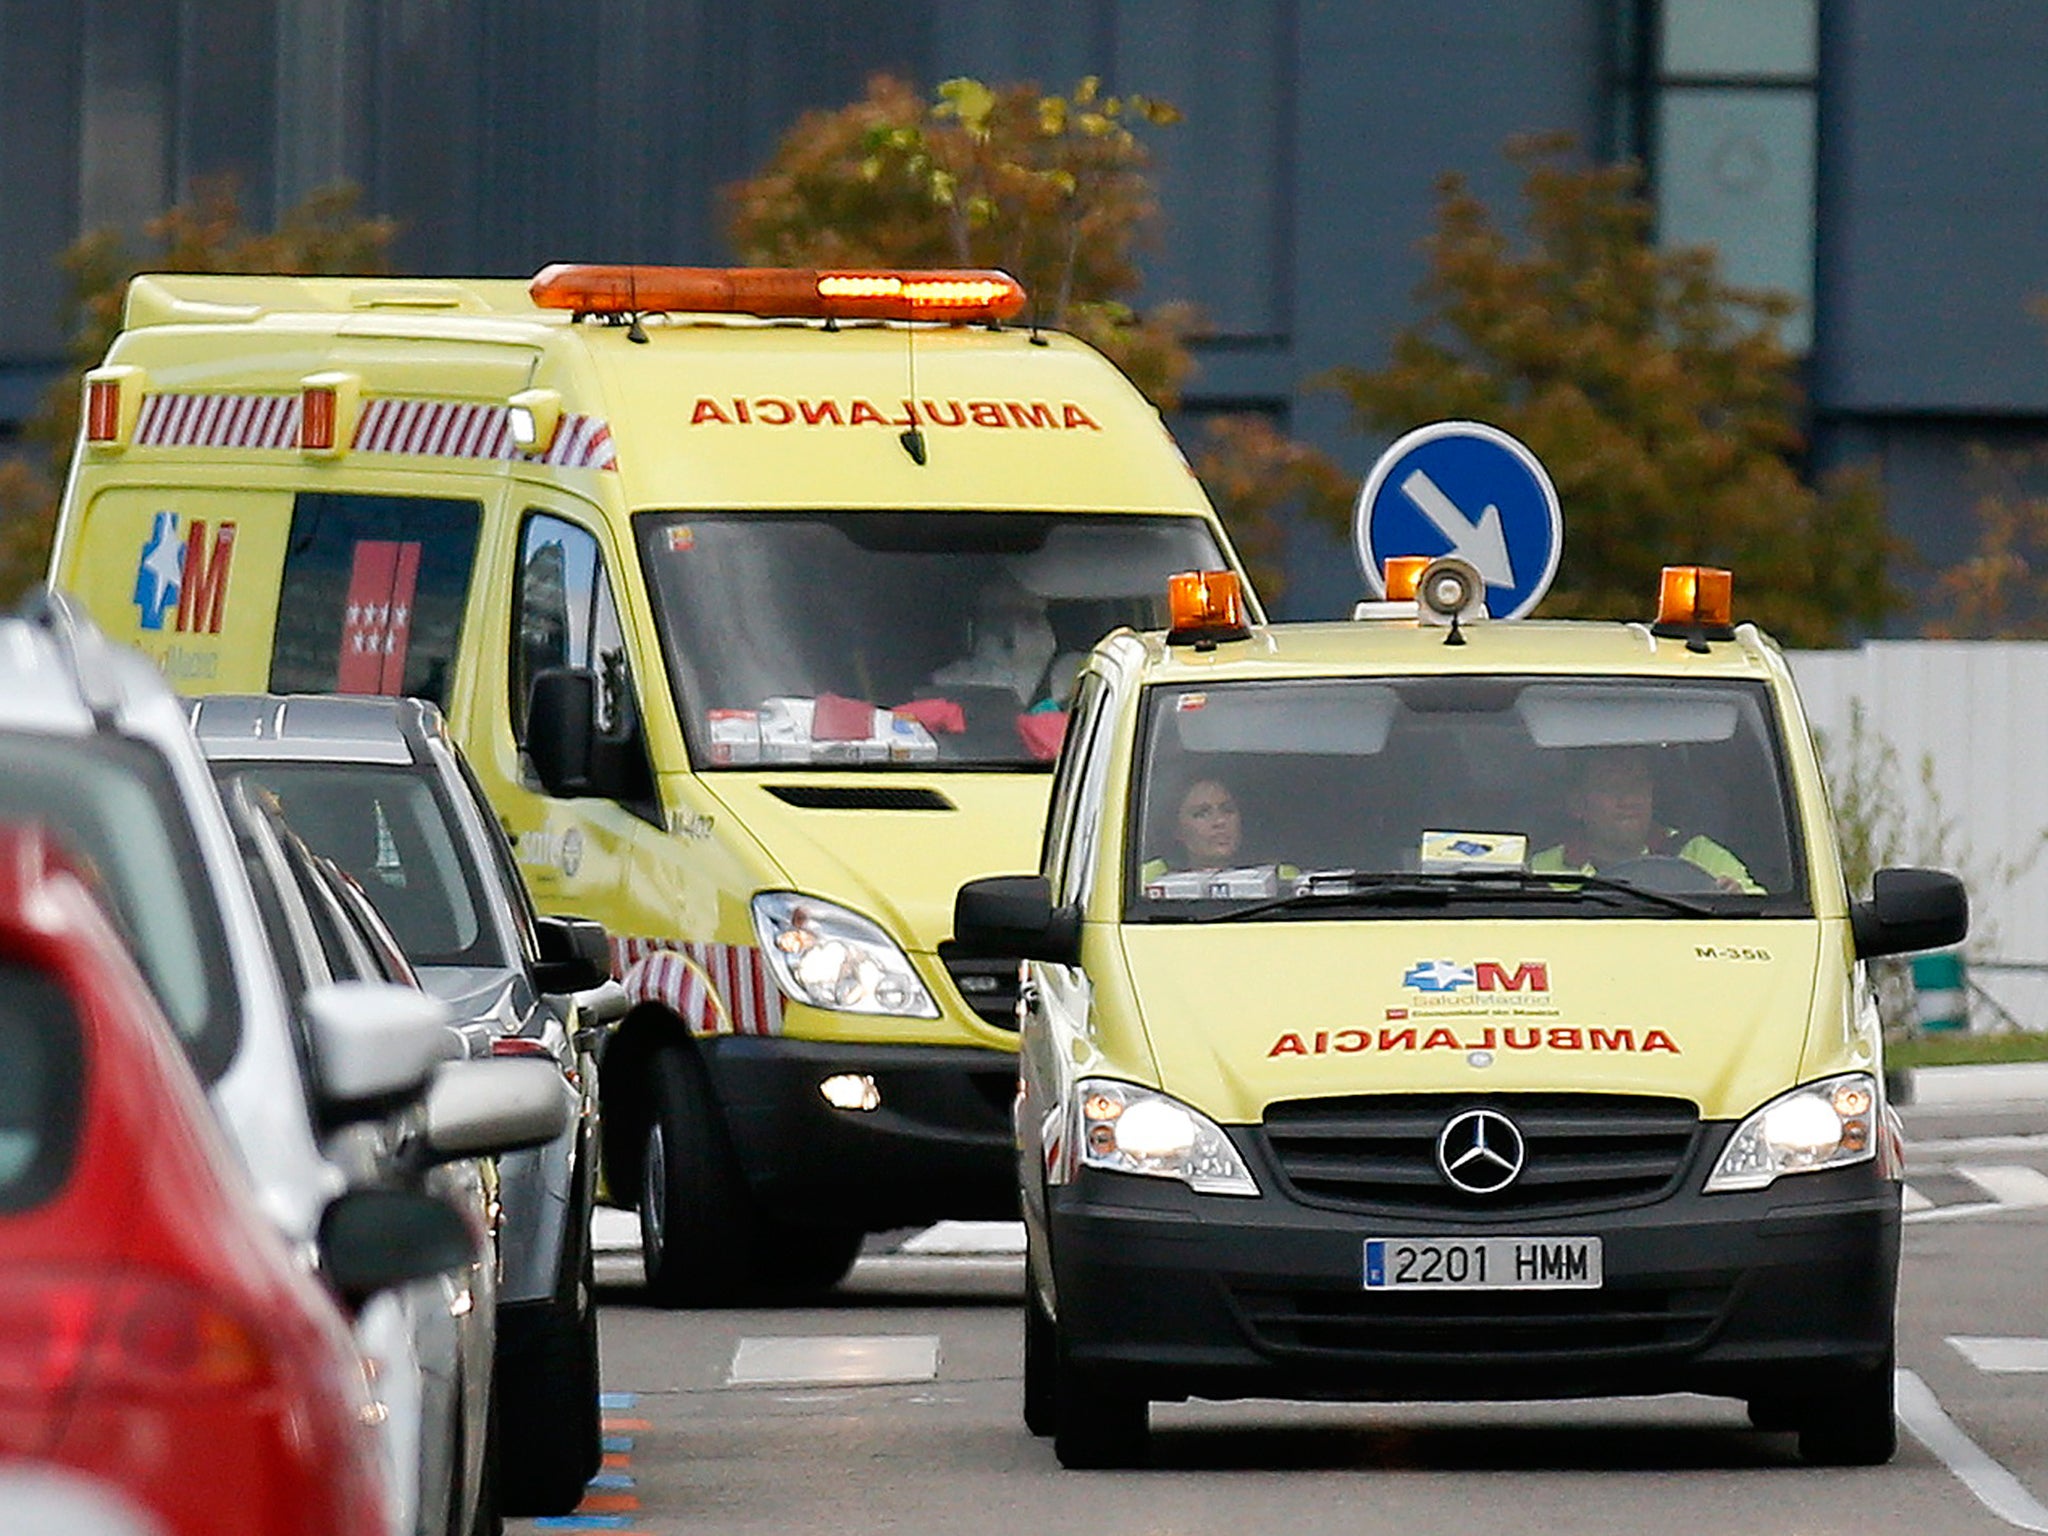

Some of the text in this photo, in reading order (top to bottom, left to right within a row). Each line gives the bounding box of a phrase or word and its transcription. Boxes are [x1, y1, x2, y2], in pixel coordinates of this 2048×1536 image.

[1475, 962, 1549, 991] M
[1396, 1245, 1486, 1283] 2201
[1515, 1244, 1588, 1281] HMM
